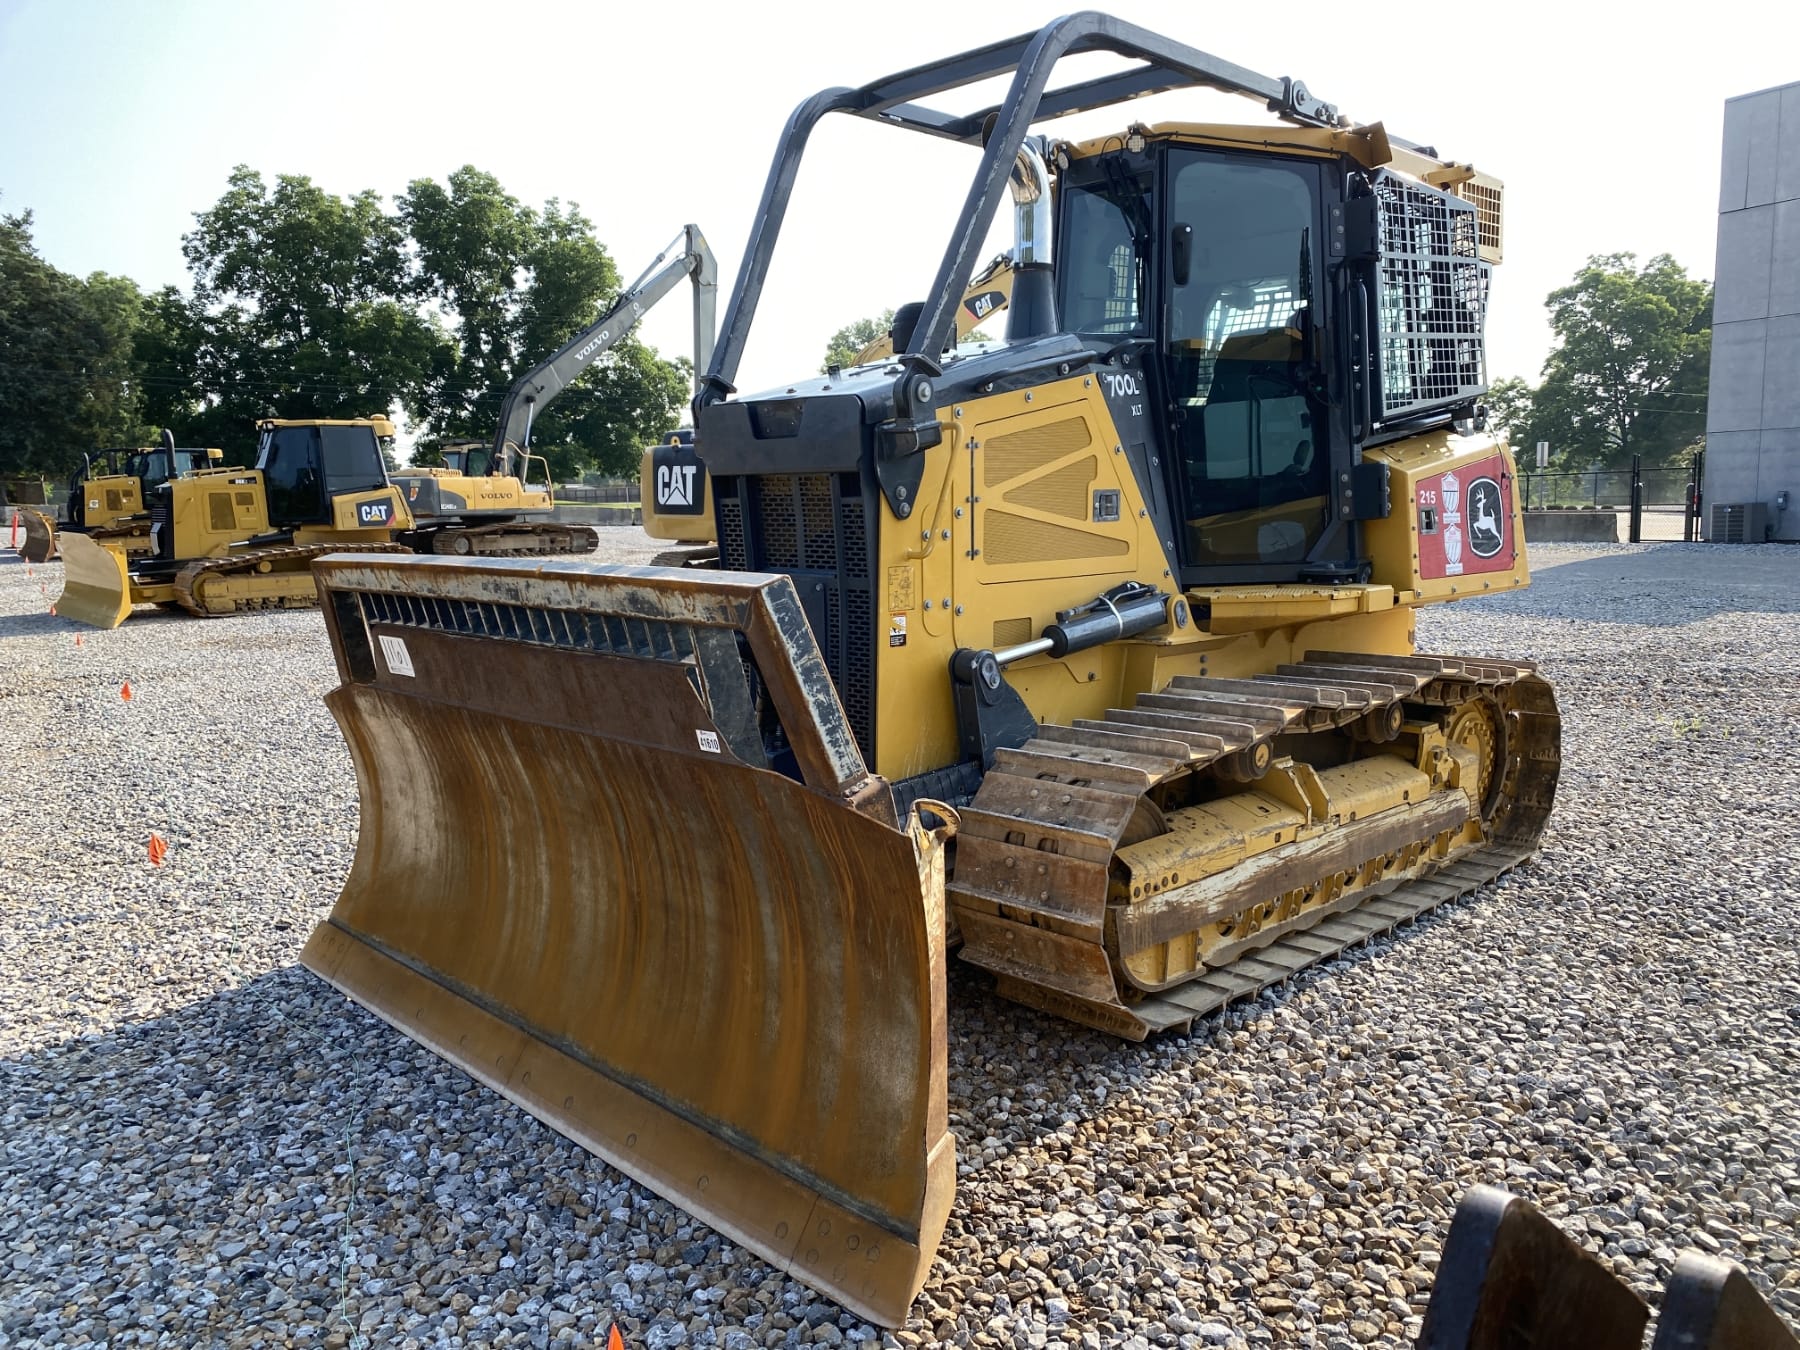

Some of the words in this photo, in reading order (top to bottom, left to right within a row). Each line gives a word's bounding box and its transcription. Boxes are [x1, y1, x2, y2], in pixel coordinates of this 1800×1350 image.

[975, 293, 993, 317] CAT
[574, 330, 610, 361] VOLVO
[1106, 373, 1141, 397] 700L
[480, 492, 513, 500] VOLVO
[657, 465, 697, 506] CAT
[1420, 490, 1436, 504] 215
[361, 504, 387, 522] CAT
